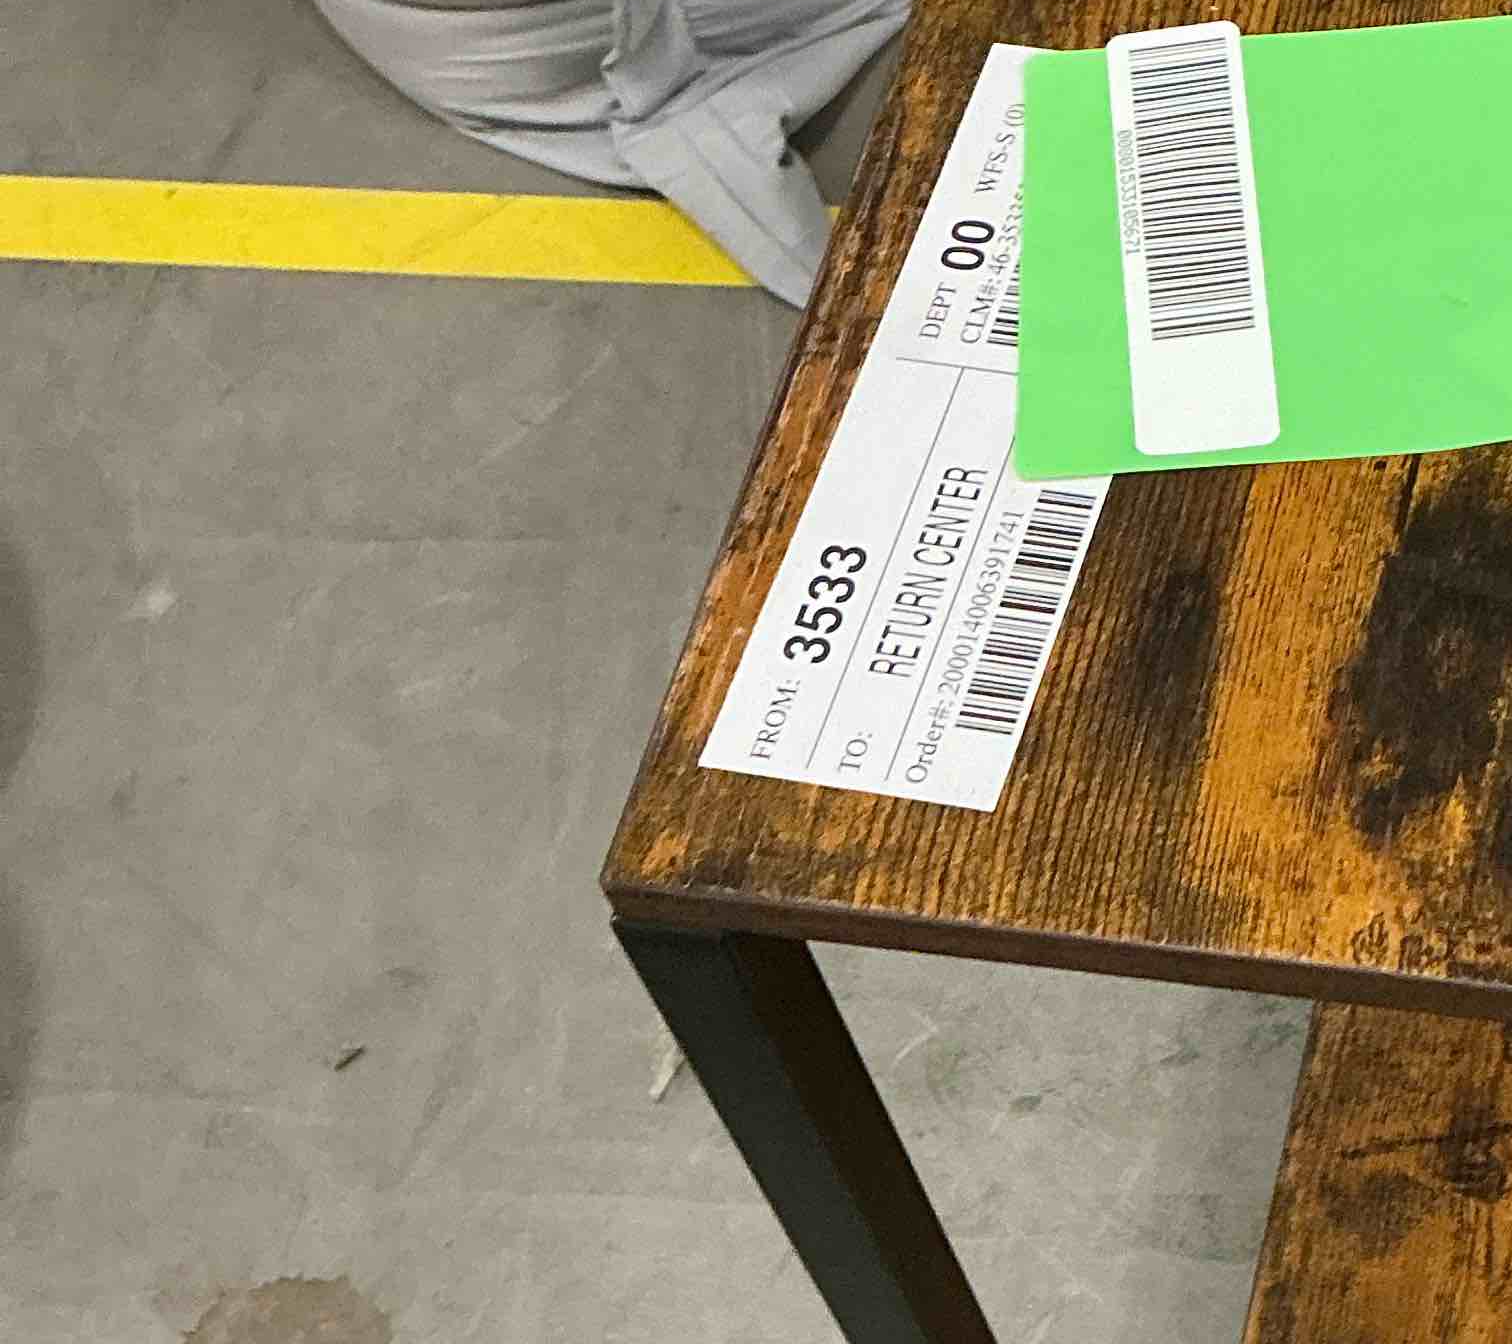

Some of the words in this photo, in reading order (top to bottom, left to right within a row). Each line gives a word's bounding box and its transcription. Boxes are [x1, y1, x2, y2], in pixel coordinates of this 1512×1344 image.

[919, 282, 957, 339] DEPT
[941, 220, 995, 270] 00
[975, 132, 1016, 194] WFS-S
[751, 679, 801, 760] FROM:
[783, 545, 867, 664] 3533
[838, 731, 873, 773] TO:
[869, 571, 949, 678] RETURN
[913, 466, 989, 567] CENTER
